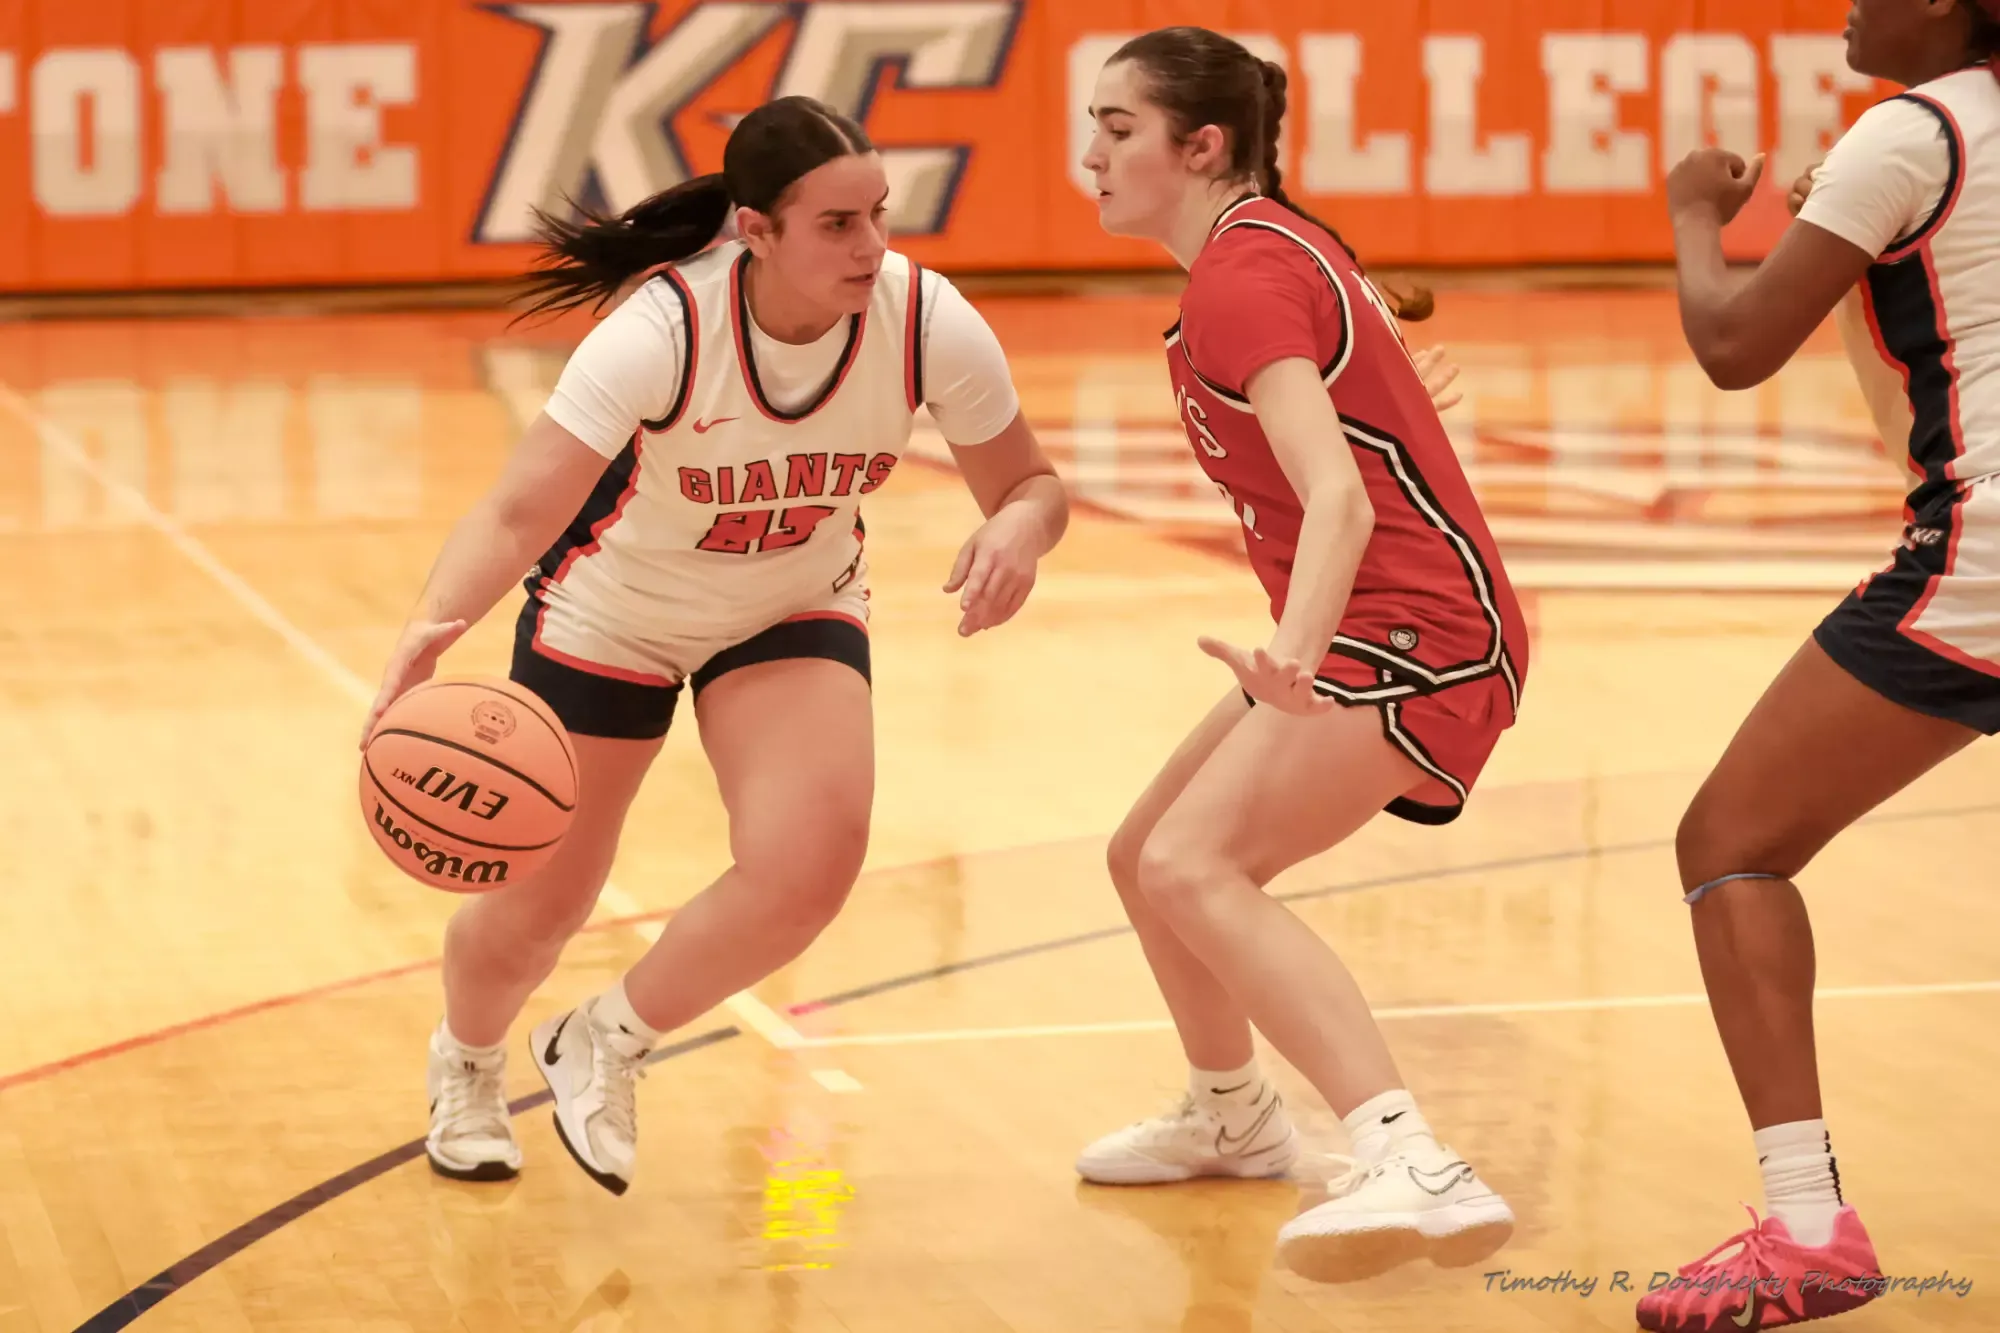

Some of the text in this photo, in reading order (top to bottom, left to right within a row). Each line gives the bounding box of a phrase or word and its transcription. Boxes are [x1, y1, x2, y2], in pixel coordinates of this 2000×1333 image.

[0, 45, 418, 216] ONE
[466, 0, 1022, 243] KC
[678, 452, 898, 505] GIANTS
[391, 766, 509, 821] EVO NXT
[374, 801, 509, 884] Wilson
